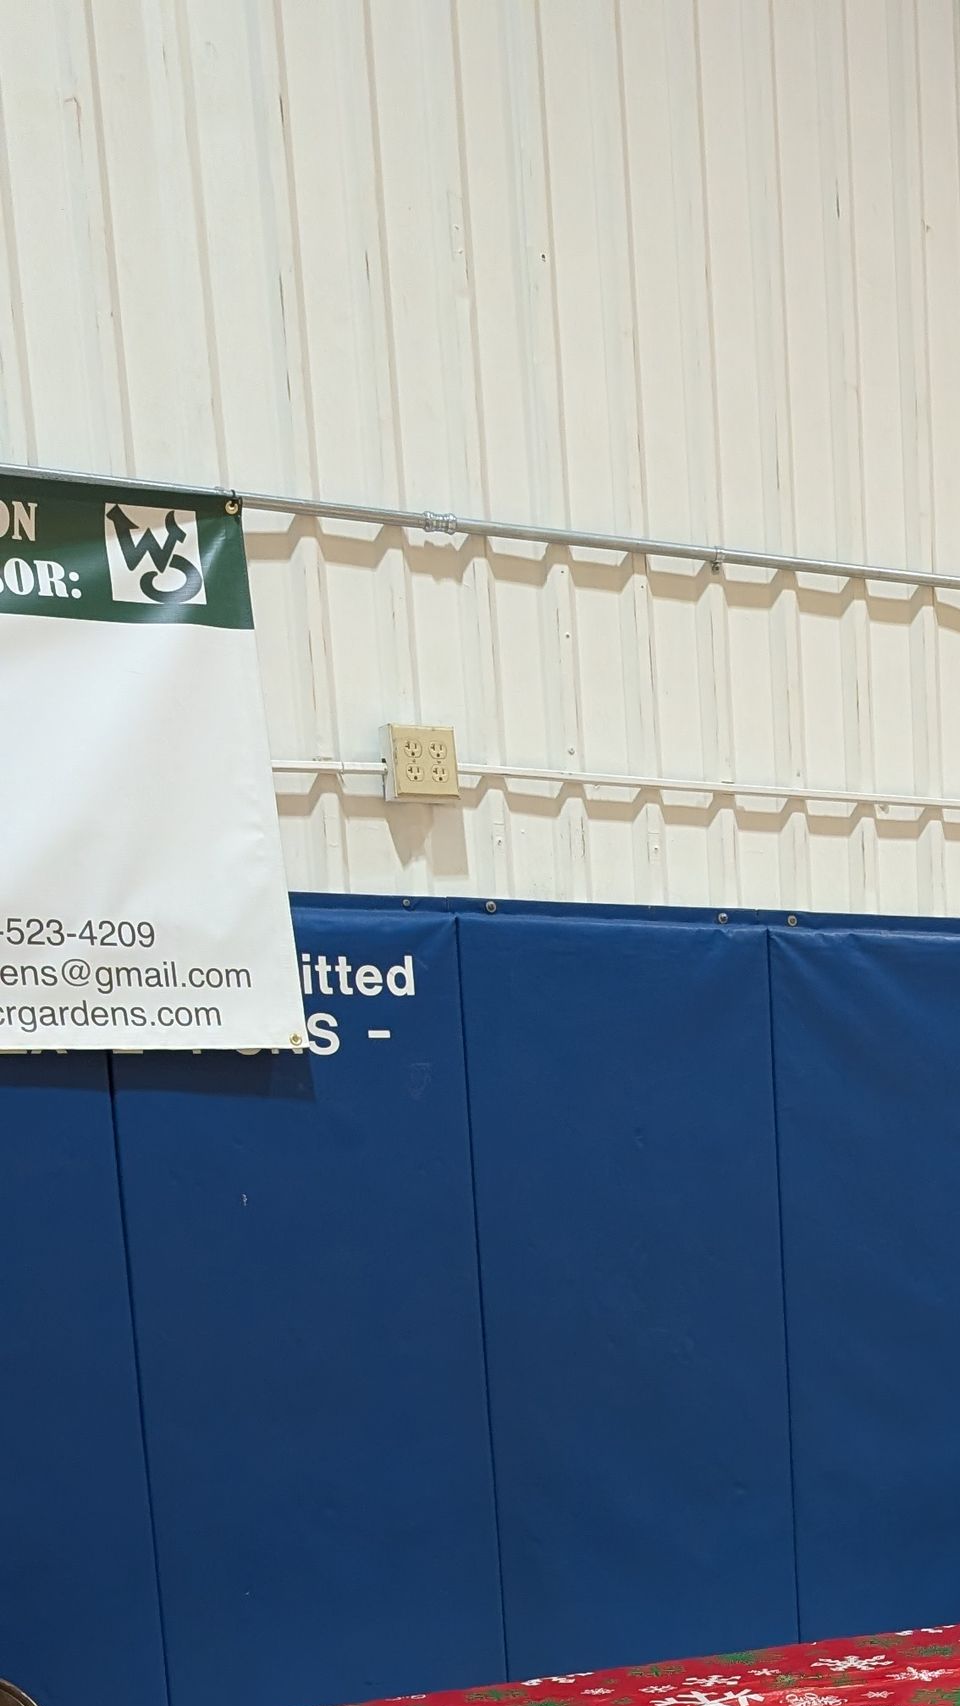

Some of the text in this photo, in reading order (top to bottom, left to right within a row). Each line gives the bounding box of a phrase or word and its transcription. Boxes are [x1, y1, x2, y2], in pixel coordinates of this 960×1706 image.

[0, 557, 82, 599] OR:
[0, 958, 252, 995] ens@gmail.com
[301, 953, 416, 997] itted
